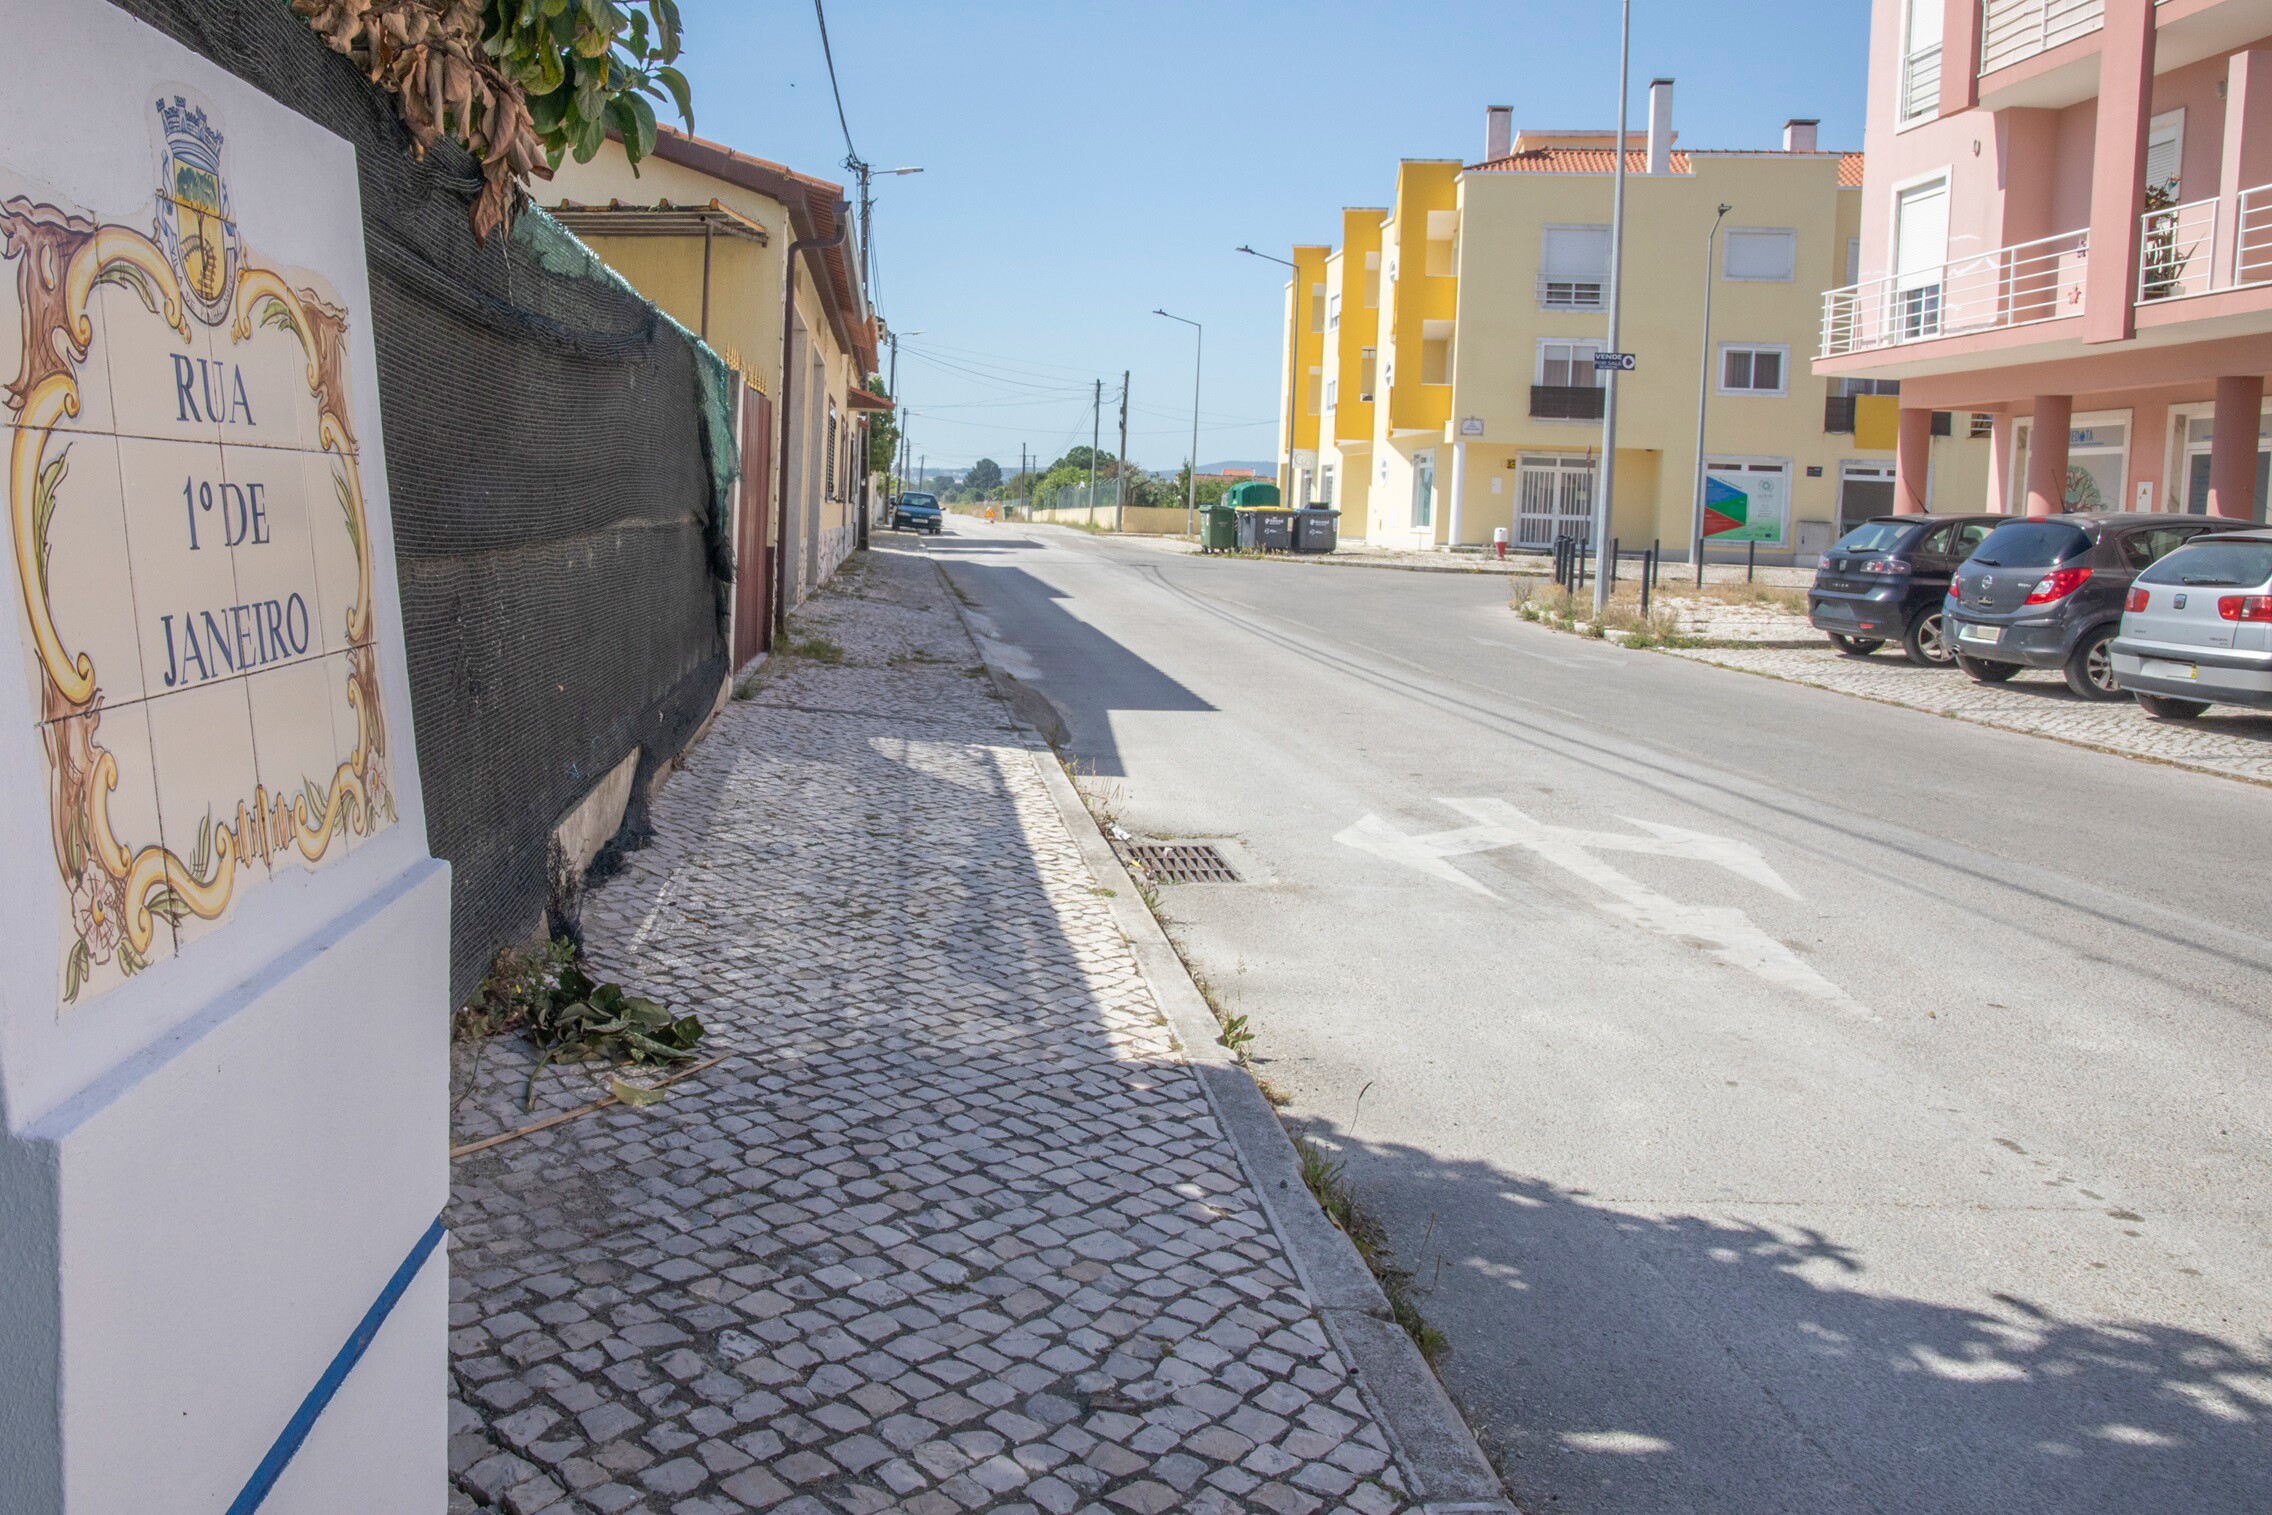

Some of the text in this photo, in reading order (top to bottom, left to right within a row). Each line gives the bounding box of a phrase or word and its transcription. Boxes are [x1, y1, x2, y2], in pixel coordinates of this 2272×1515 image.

[170, 353, 256, 425] RUA
[219, 483, 270, 547] DE
[161, 592, 309, 687] JANEIRO
